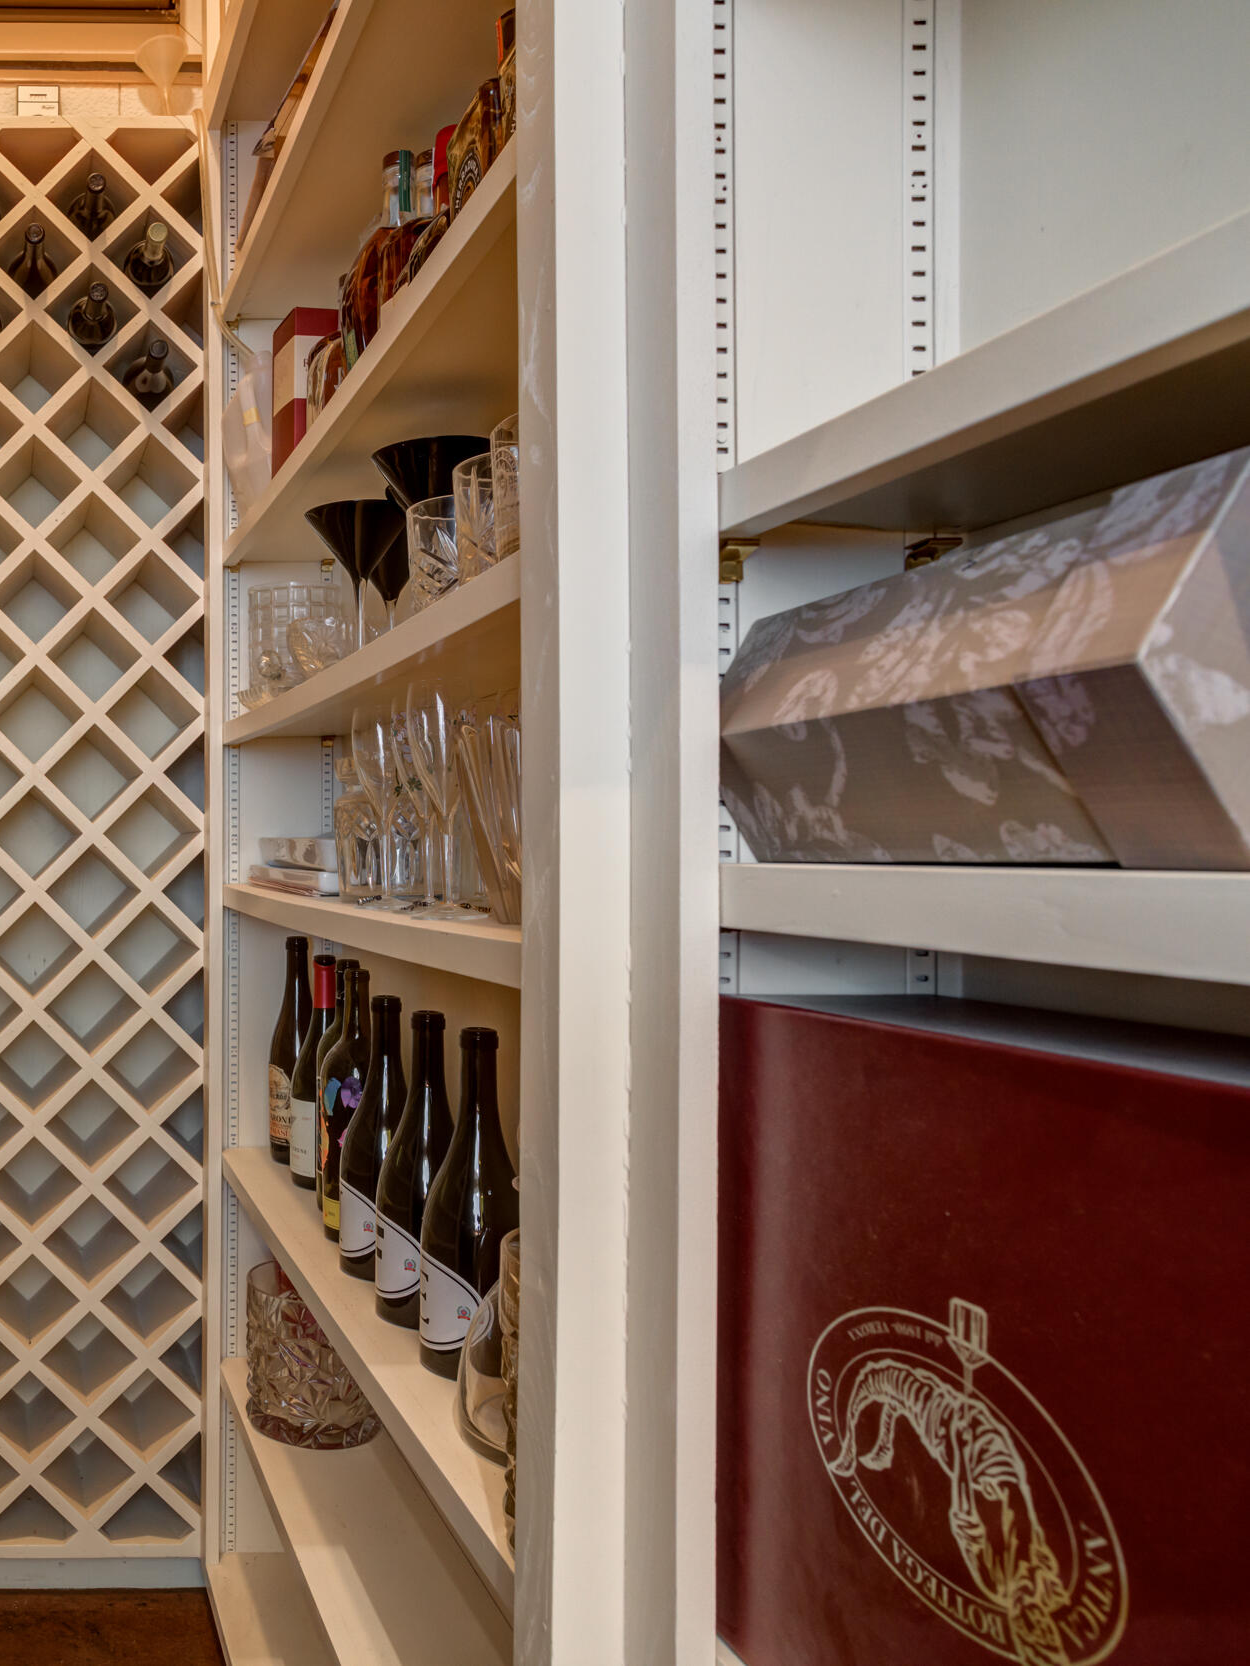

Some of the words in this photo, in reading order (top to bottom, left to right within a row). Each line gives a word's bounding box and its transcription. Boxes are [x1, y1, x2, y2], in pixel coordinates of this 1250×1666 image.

[816, 1368, 835, 1445] VINO
[851, 1481, 887, 1543] DEL
[892, 1538, 1007, 1645] BOTTEGA
[1059, 1520, 1114, 1649] ANTICA
